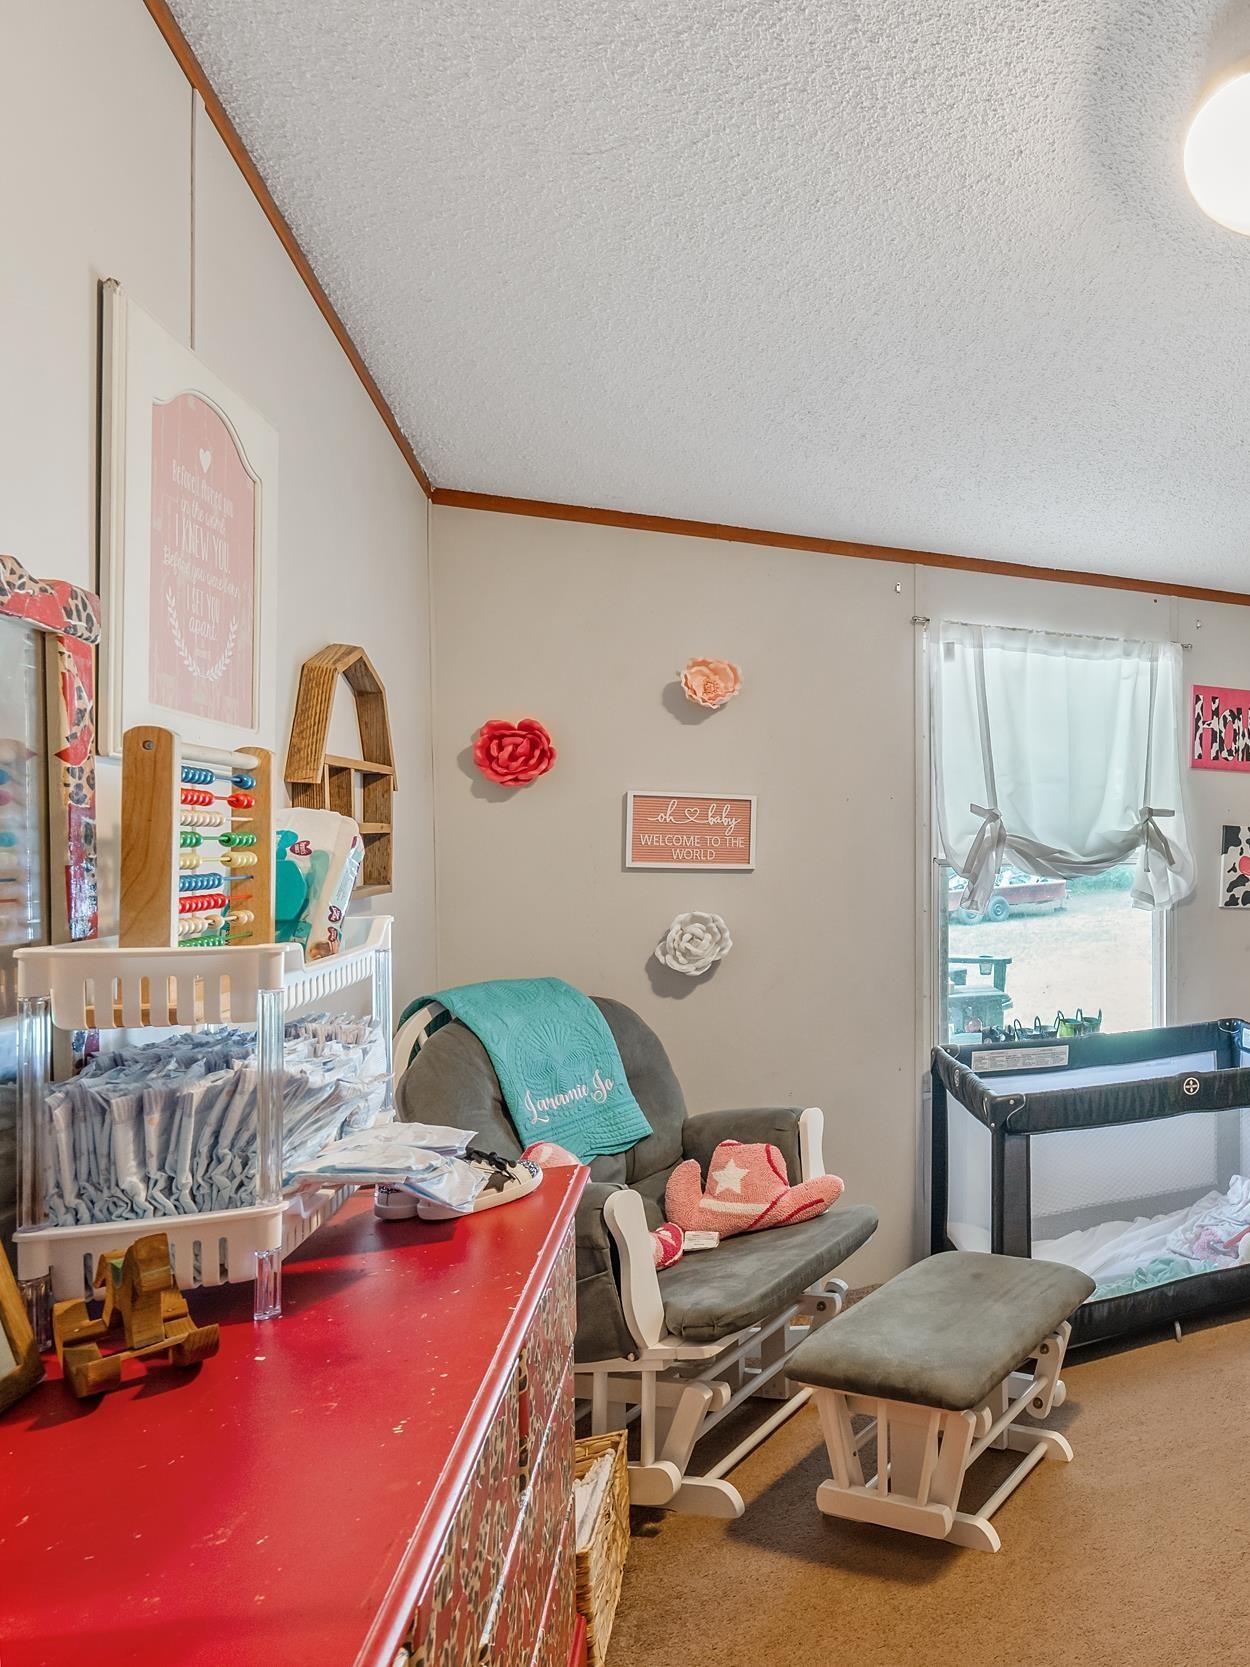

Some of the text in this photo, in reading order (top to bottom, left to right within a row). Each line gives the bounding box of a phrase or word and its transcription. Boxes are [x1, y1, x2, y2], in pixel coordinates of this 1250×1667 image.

[182, 517, 209, 561] KNEW
[648, 799, 742, 836] oh baby
[640, 833, 745, 849] WELCOME TO THE
[672, 848, 716, 861] WORLD
[524, 1068, 614, 1125] Laramie Jo
